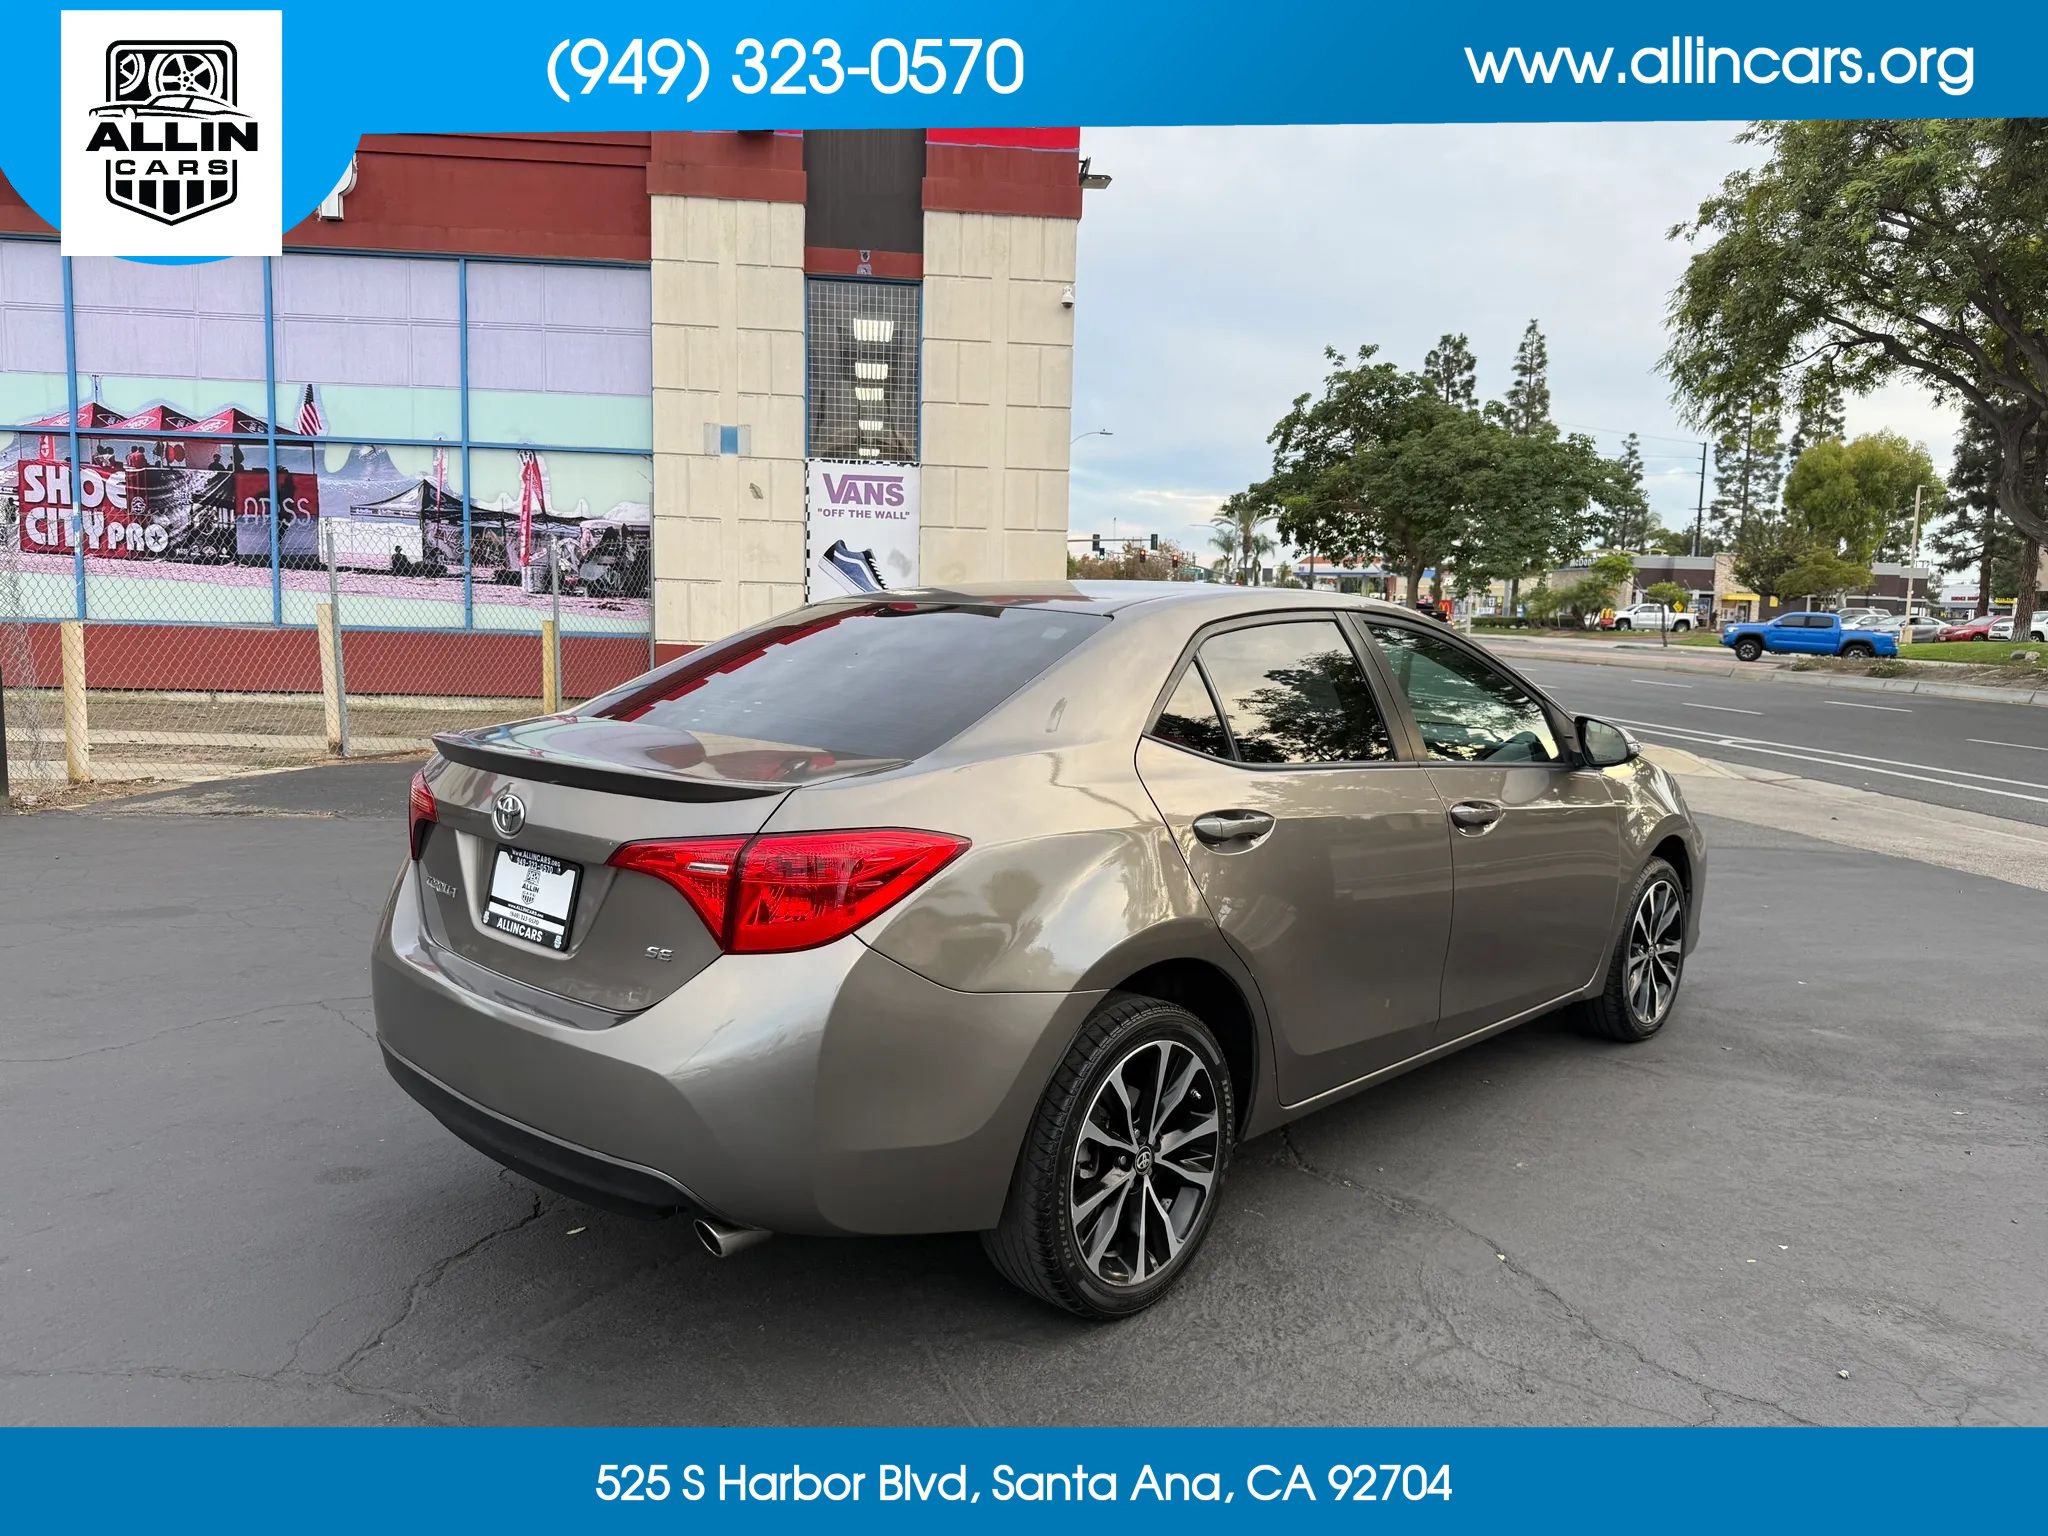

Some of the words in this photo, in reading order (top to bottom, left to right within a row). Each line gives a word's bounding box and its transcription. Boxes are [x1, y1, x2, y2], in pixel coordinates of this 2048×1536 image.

[24, 464, 126, 508] SHOE
[823, 473, 905, 507] VANS
[848, 509, 872, 519] THE
[26, 507, 104, 549] CITY
[108, 522, 168, 553] PRO
[521, 883, 540, 894] ALLIN
[496, 917, 543, 942] ALLINCARS
[644, 946, 673, 961] SE
